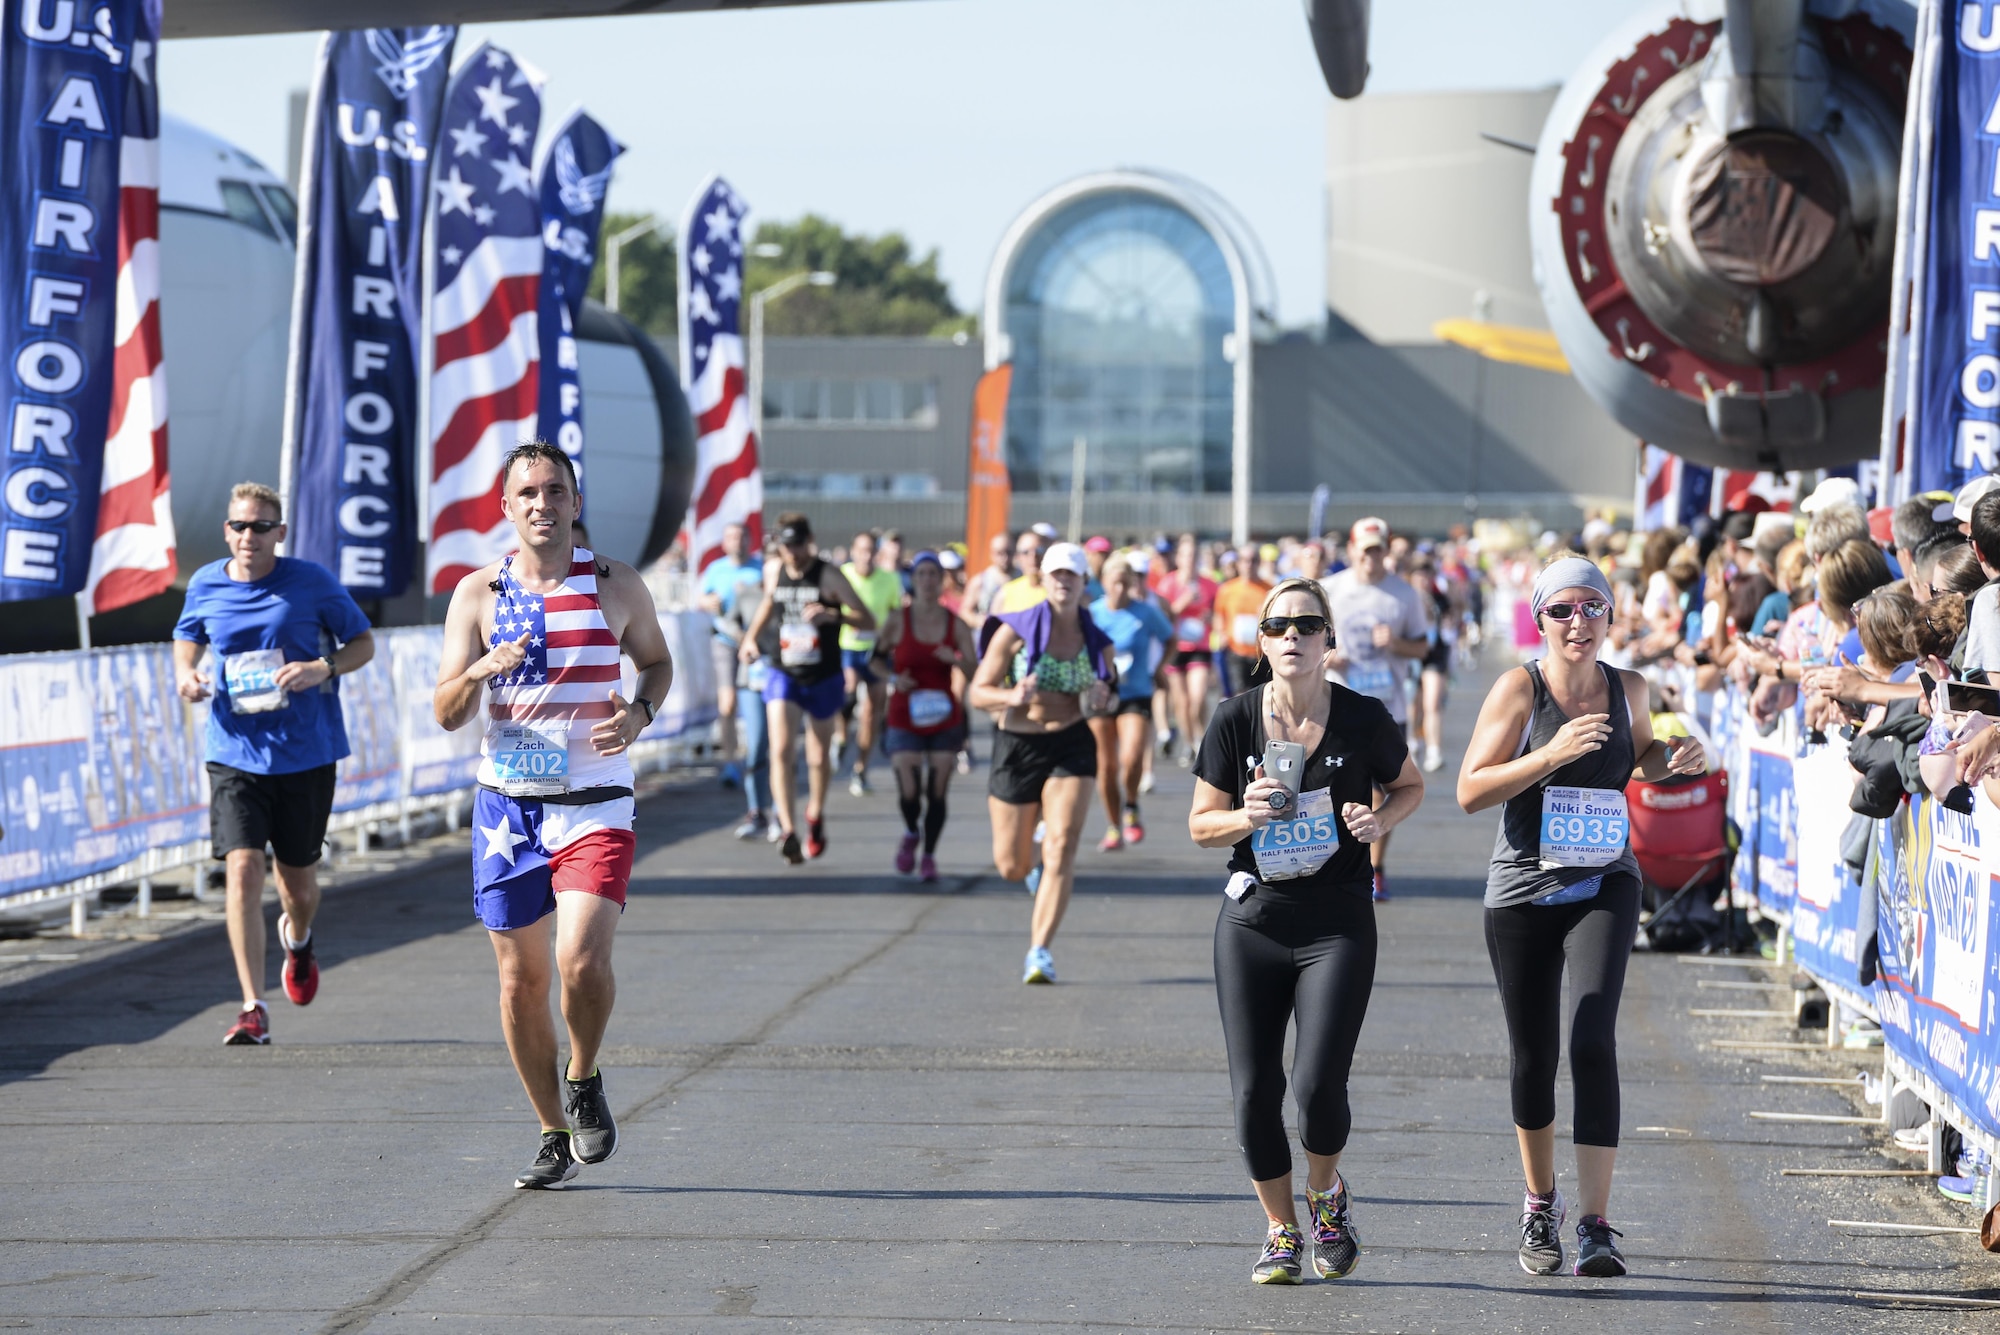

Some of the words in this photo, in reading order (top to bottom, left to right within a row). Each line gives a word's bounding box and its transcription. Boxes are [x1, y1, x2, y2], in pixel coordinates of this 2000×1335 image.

[337, 103, 428, 162] U.S.
[35, 77, 107, 253] AIR
[352, 175, 400, 320] AIR
[3, 277, 83, 583] FORCE
[339, 340, 394, 588] FORCE
[515, 741, 545, 750] Zach
[500, 753, 563, 775] 7402
[1551, 802, 1580, 814] Niki
[1585, 804, 1622, 816] Snow
[1258, 817, 1332, 848] 7505
[1547, 816, 1623, 845] 6935
[1261, 849, 1281, 858] HALF
[1283, 844, 1329, 855] MARATHON
